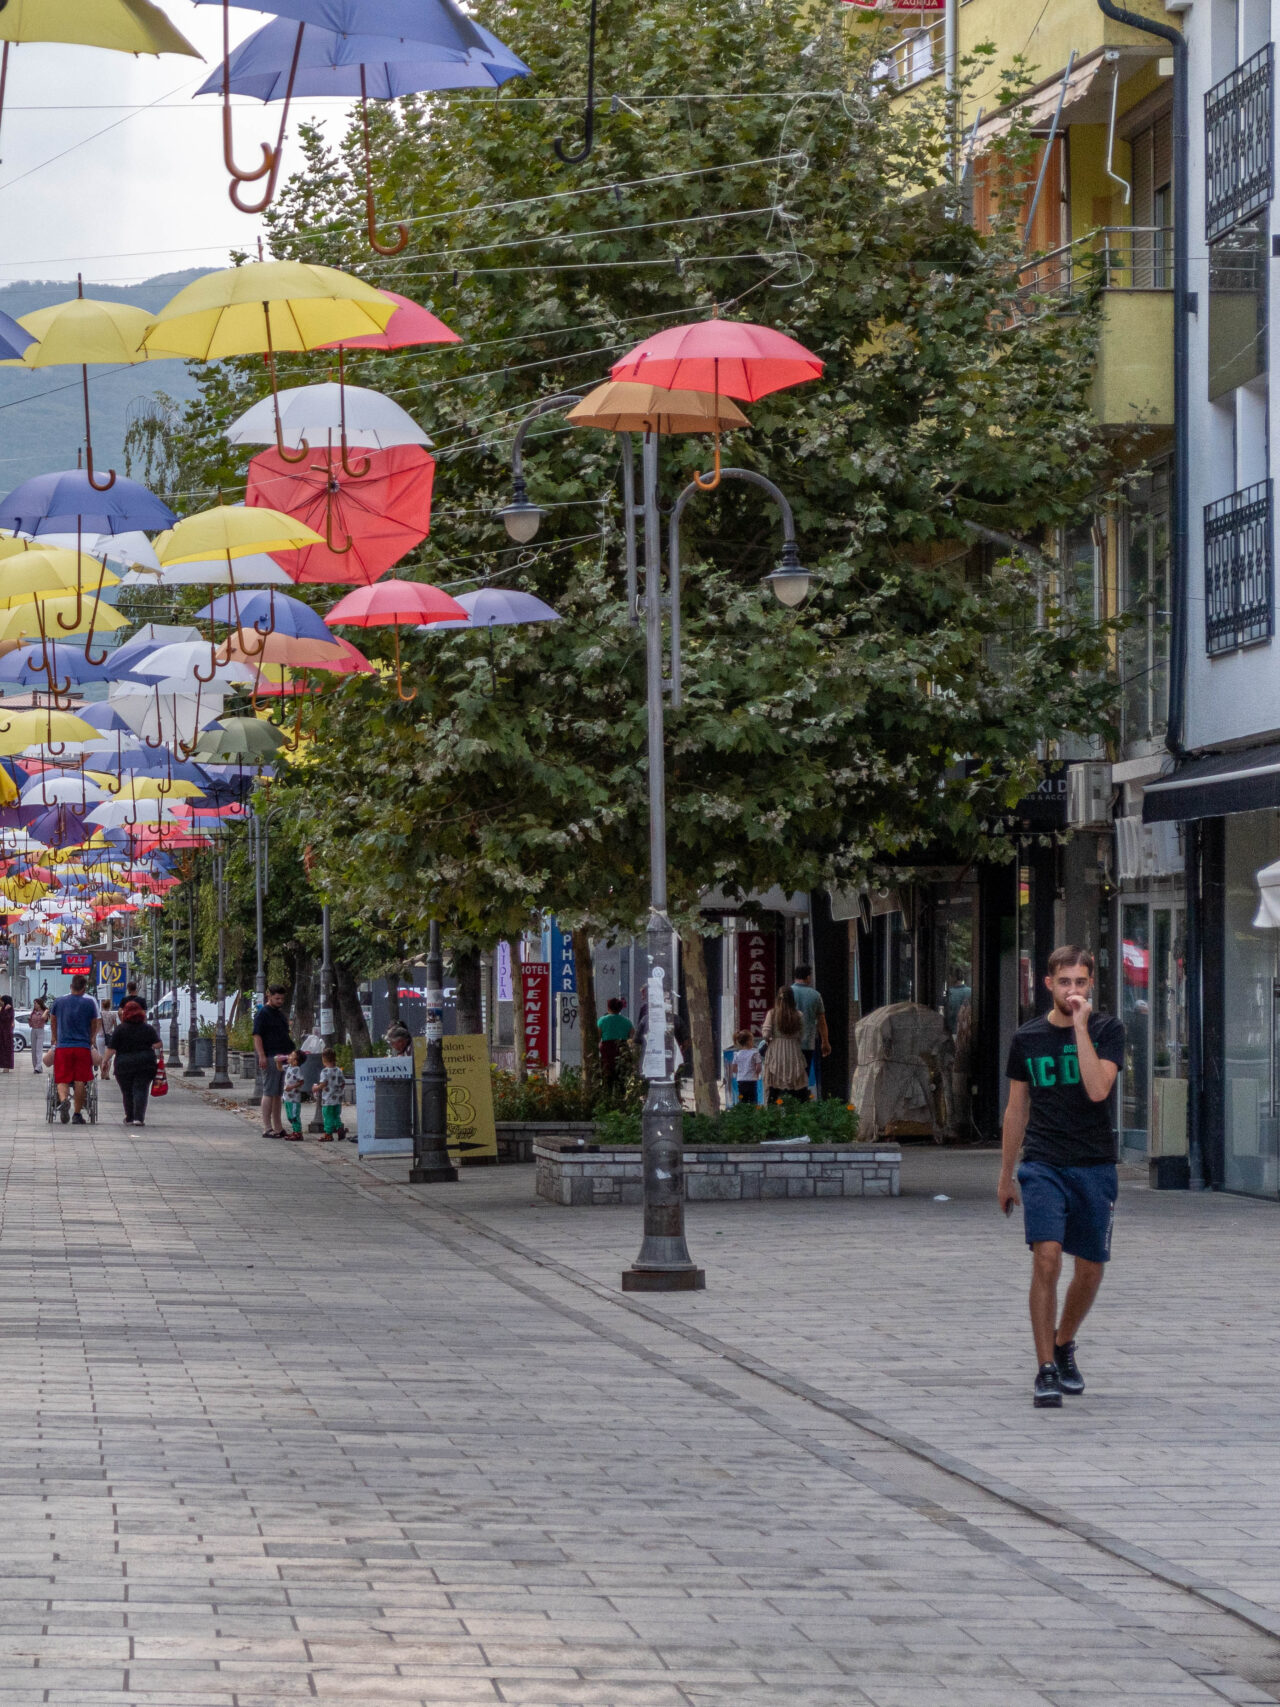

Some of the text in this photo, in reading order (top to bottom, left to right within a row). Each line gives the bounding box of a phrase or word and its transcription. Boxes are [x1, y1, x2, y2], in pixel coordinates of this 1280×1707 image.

[500, 943, 508, 998] VIOLA
[562, 934, 573, 991] PHAR
[748, 936, 767, 1037] APARTMEN
[443, 1042, 464, 1051] alon
[525, 978, 542, 1060] VENECIA
[563, 1008, 578, 1030] 89
[1025, 1055, 1080, 1087] ICO
